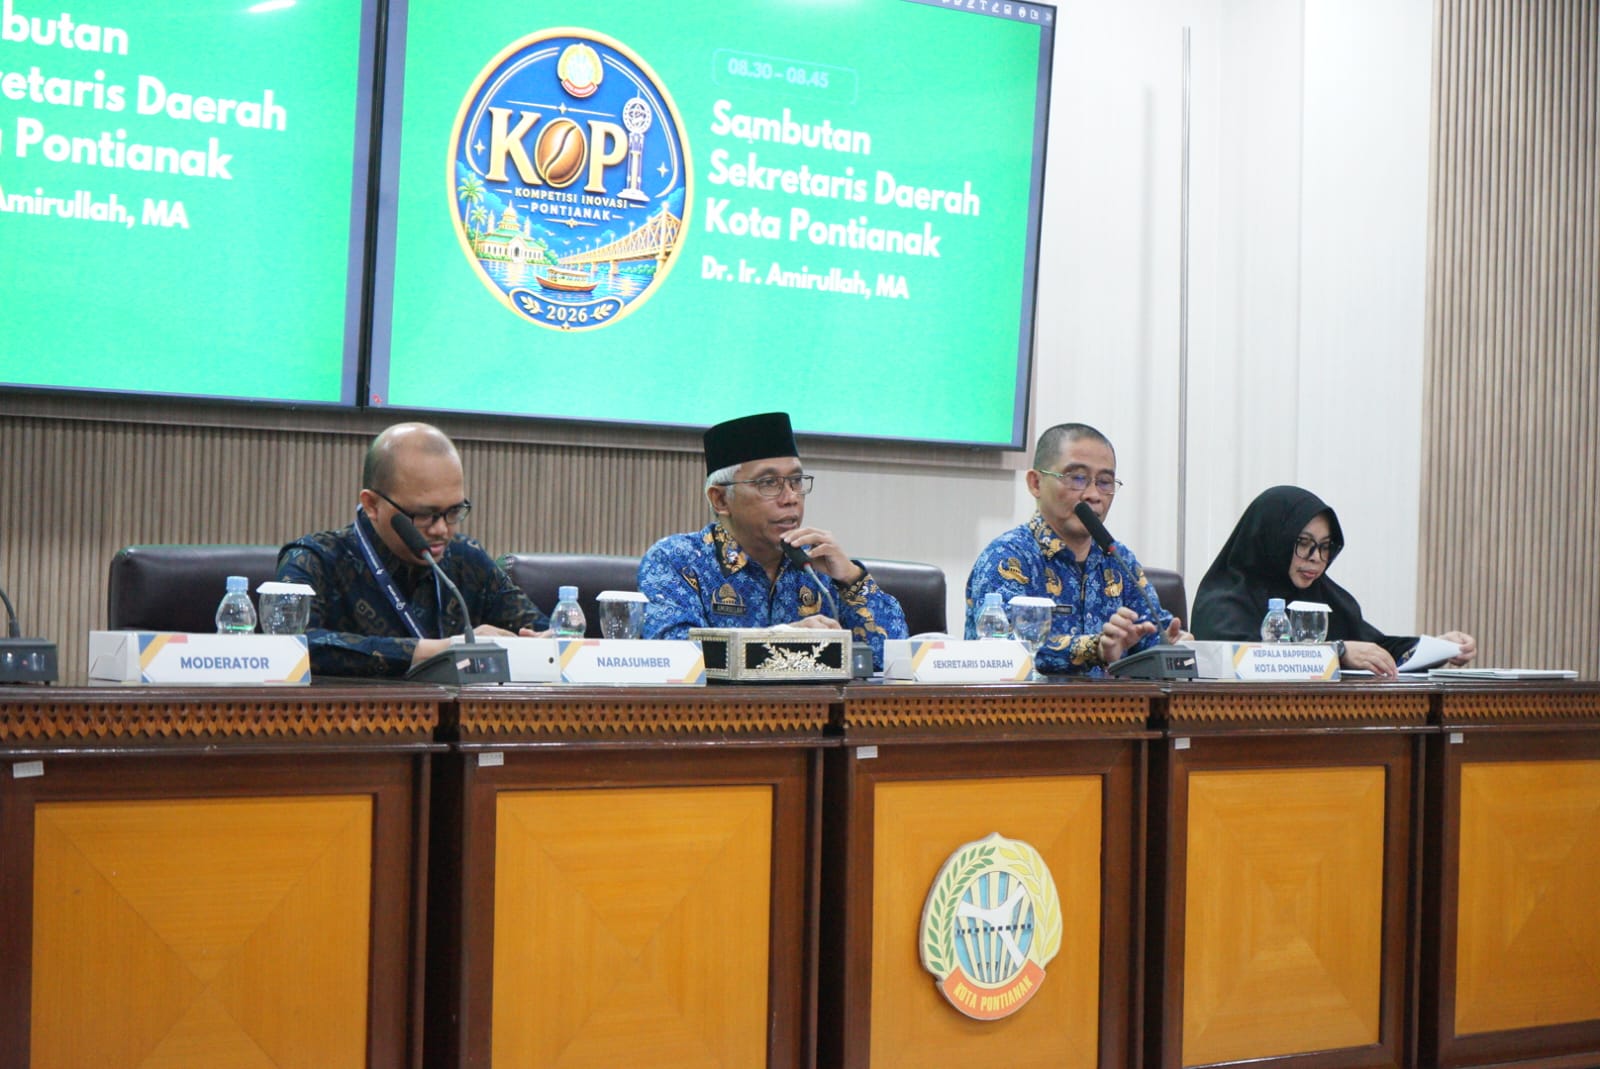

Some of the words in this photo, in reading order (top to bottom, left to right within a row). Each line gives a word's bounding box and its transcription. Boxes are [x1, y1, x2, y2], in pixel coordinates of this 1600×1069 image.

[727, 57, 773, 79] 08.30
[786, 67, 829, 88] 08.45
[0, 66, 126, 111] etaris
[138, 76, 287, 130] Daerah
[711, 100, 871, 154] Sambutan
[16, 117, 233, 179] Pontianak
[515, 187, 578, 204] KOMPETISI
[581, 195, 628, 209] INOVASI
[707, 149, 868, 202] Sekretaris
[875, 170, 980, 216] Daerah
[142, 198, 190, 229] MA
[530, 202, 611, 221] PONTIANAK
[705, 198, 782, 240] Kota
[790, 207, 941, 258] Pontianak
[701, 255, 734, 282] Dr.
[739, 258, 762, 285] Ir.
[766, 262, 872, 300] Amirullah,
[875, 273, 910, 299] MA
[546, 305, 588, 322] 2026
[180, 656, 270, 669] MODERATOR
[597, 656, 671, 668] NARASUMBER
[933, 659, 978, 669] SEKRETARIS
[980, 659, 1014, 669] DAERAH
[1253, 649, 1281, 658] KEPALA
[1282, 649, 1322, 659] BAPPERIDA
[1255, 664, 1277, 673] KOTA
[1279, 664, 1325, 673] PONTIANAK
[953, 981, 978, 1009] KOTA
[980, 975, 1033, 1012] PONTIANAK
